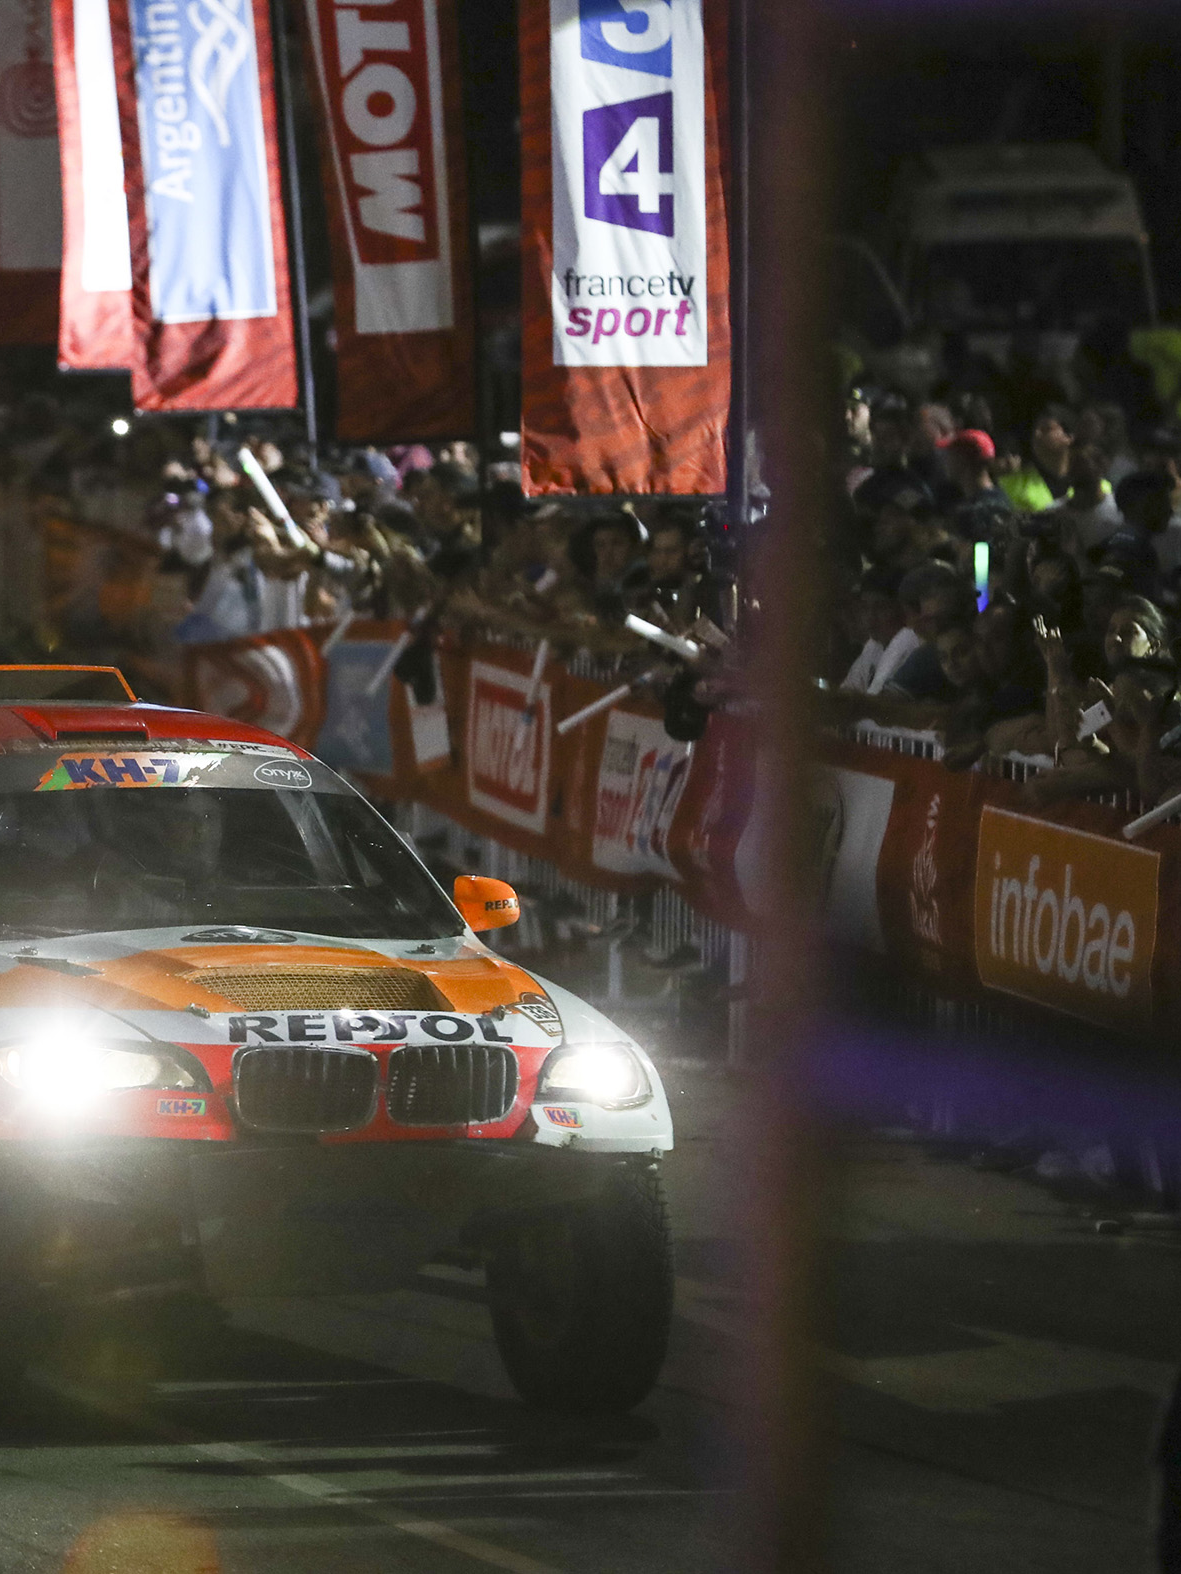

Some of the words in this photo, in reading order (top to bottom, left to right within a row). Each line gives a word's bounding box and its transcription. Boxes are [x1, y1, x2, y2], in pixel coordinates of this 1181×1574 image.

[334, 0, 427, 243] MOT
[599, 117, 673, 213] 4
[563, 267, 695, 297] francetv
[565, 300, 692, 344] sport
[61, 758, 181, 784] KH-7
[990, 851, 1136, 998] infobae
[229, 1014, 514, 1044] REPSOL
[160, 1100, 203, 1114] KH-7
[546, 1109, 579, 1125] KH-7
